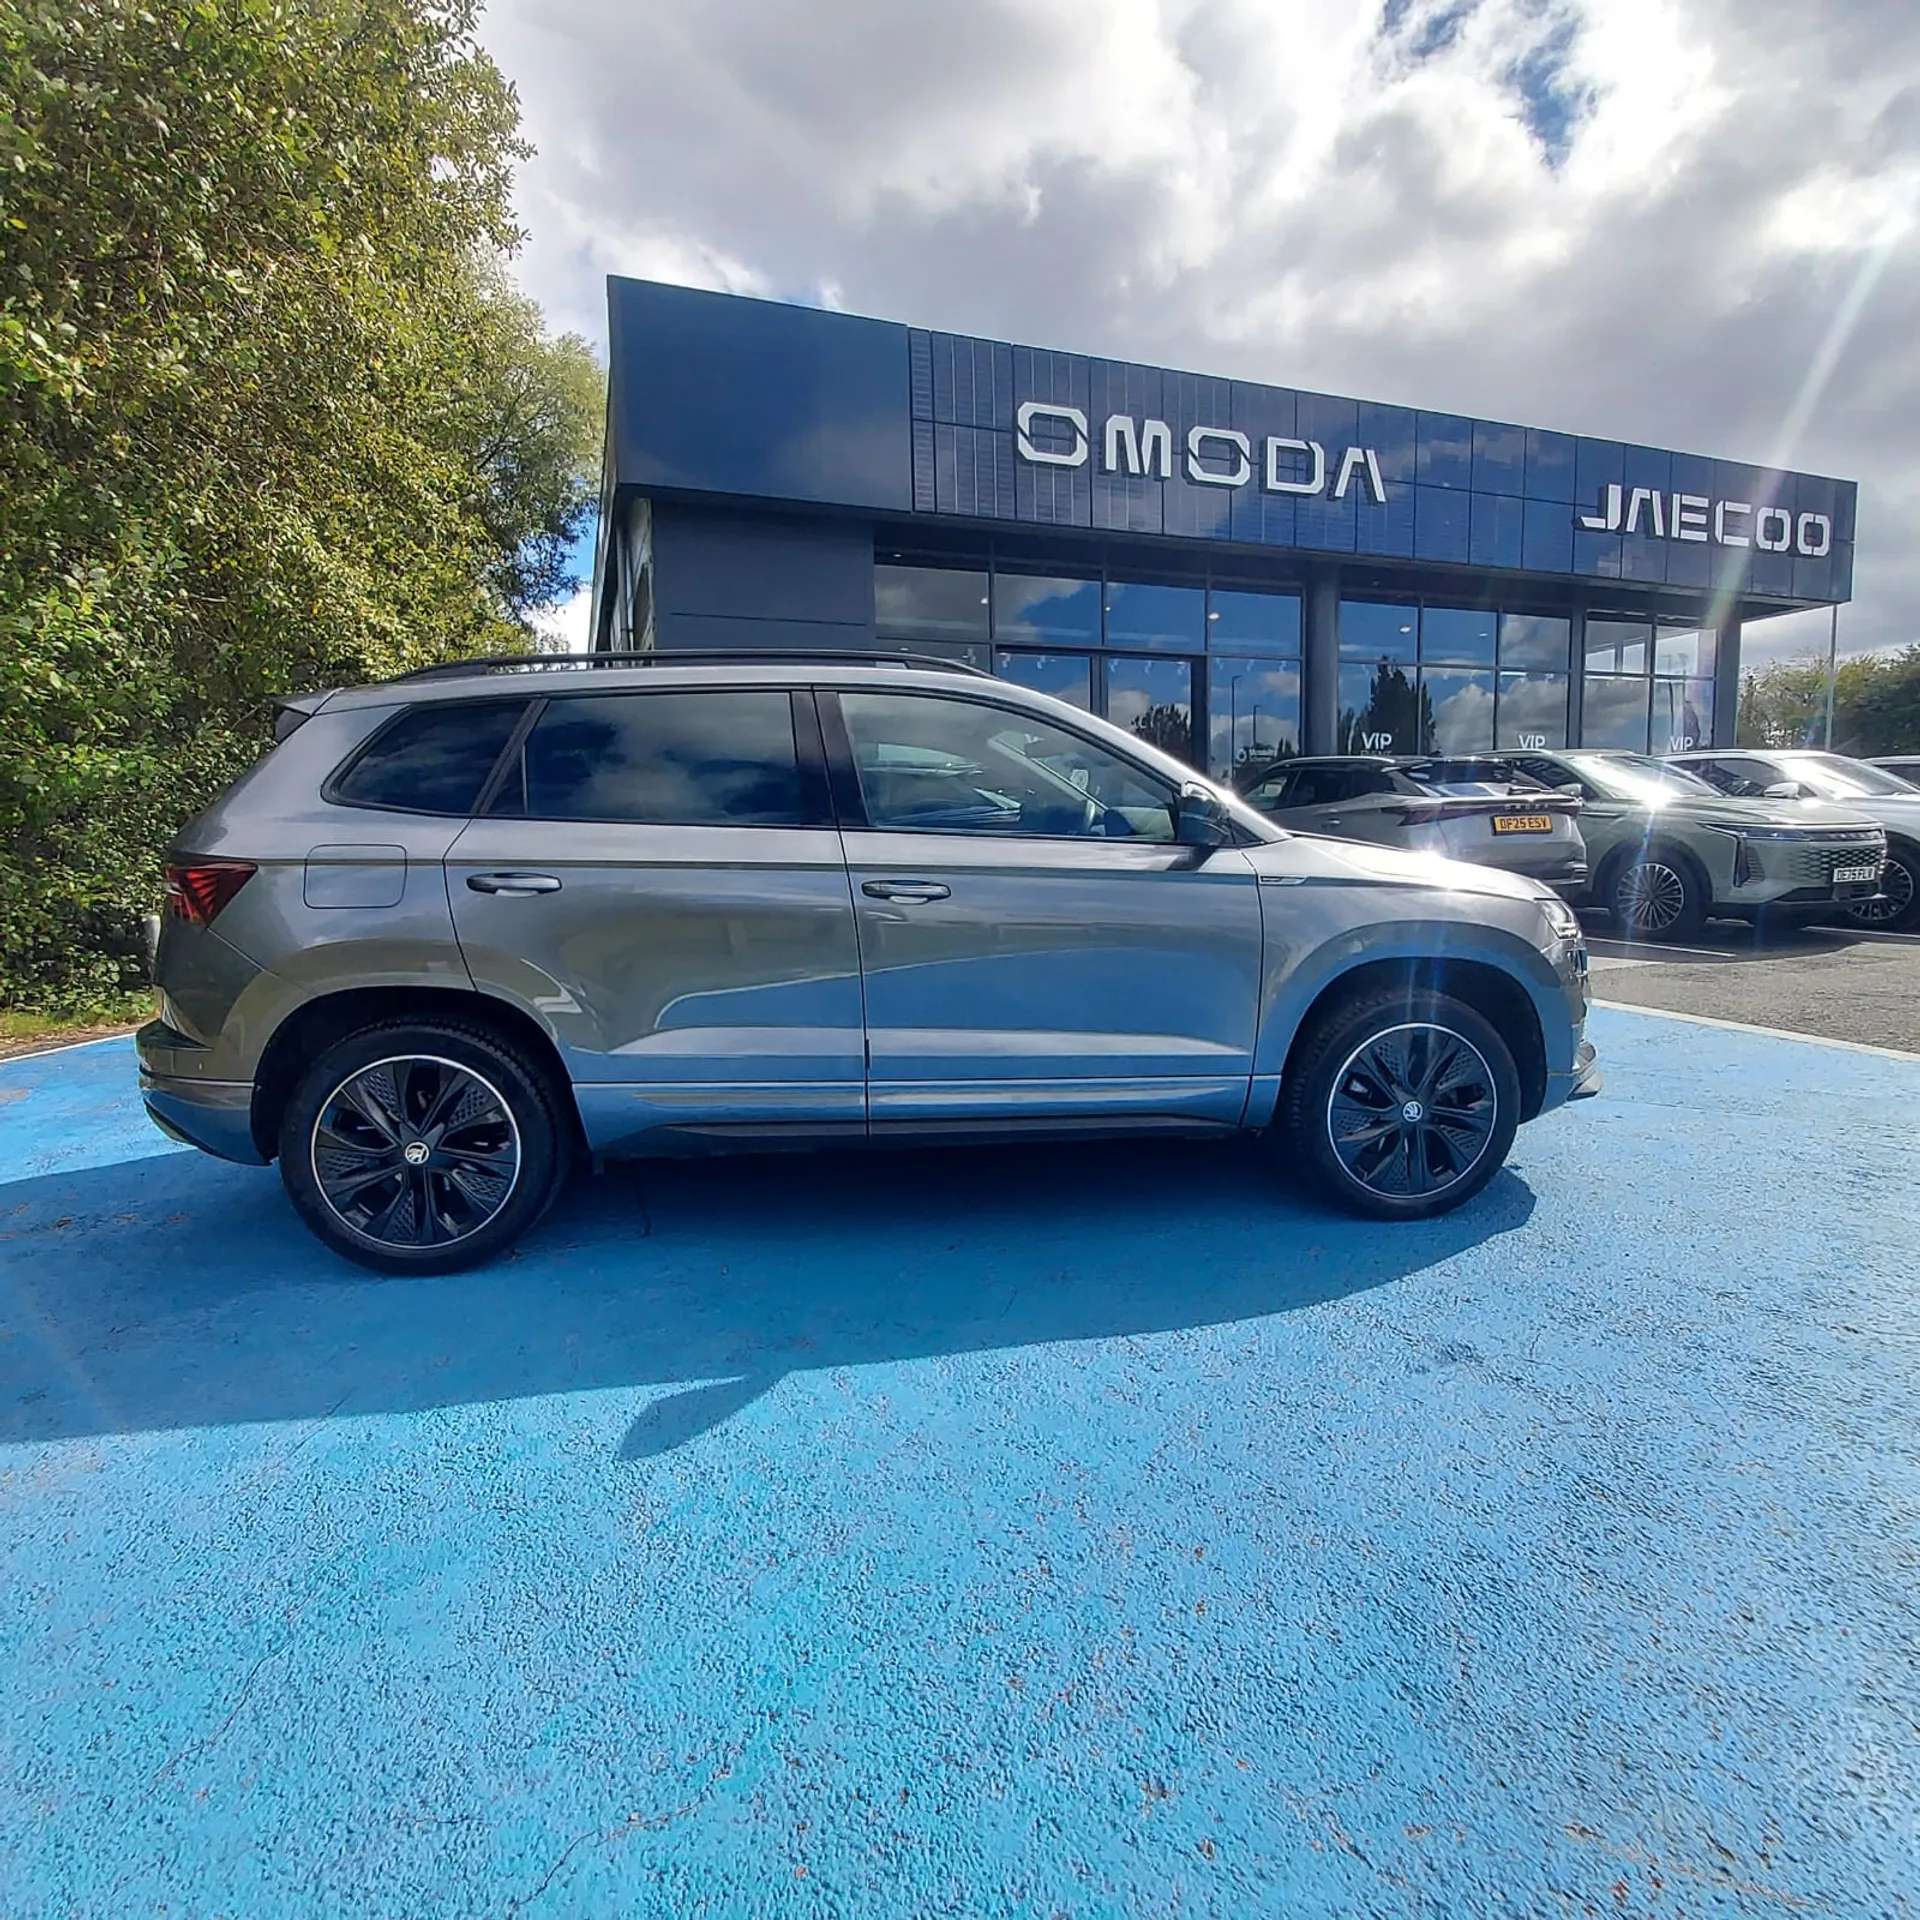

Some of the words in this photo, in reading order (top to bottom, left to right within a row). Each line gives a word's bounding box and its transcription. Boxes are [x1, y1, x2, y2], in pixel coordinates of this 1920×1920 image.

[1017, 401, 1386, 502] OMODA
[1580, 484, 1830, 556] JAECOO
[1361, 731, 1392, 750] VIP
[1519, 734, 1546, 750] VIP
[1670, 736, 1693, 751] VIP
